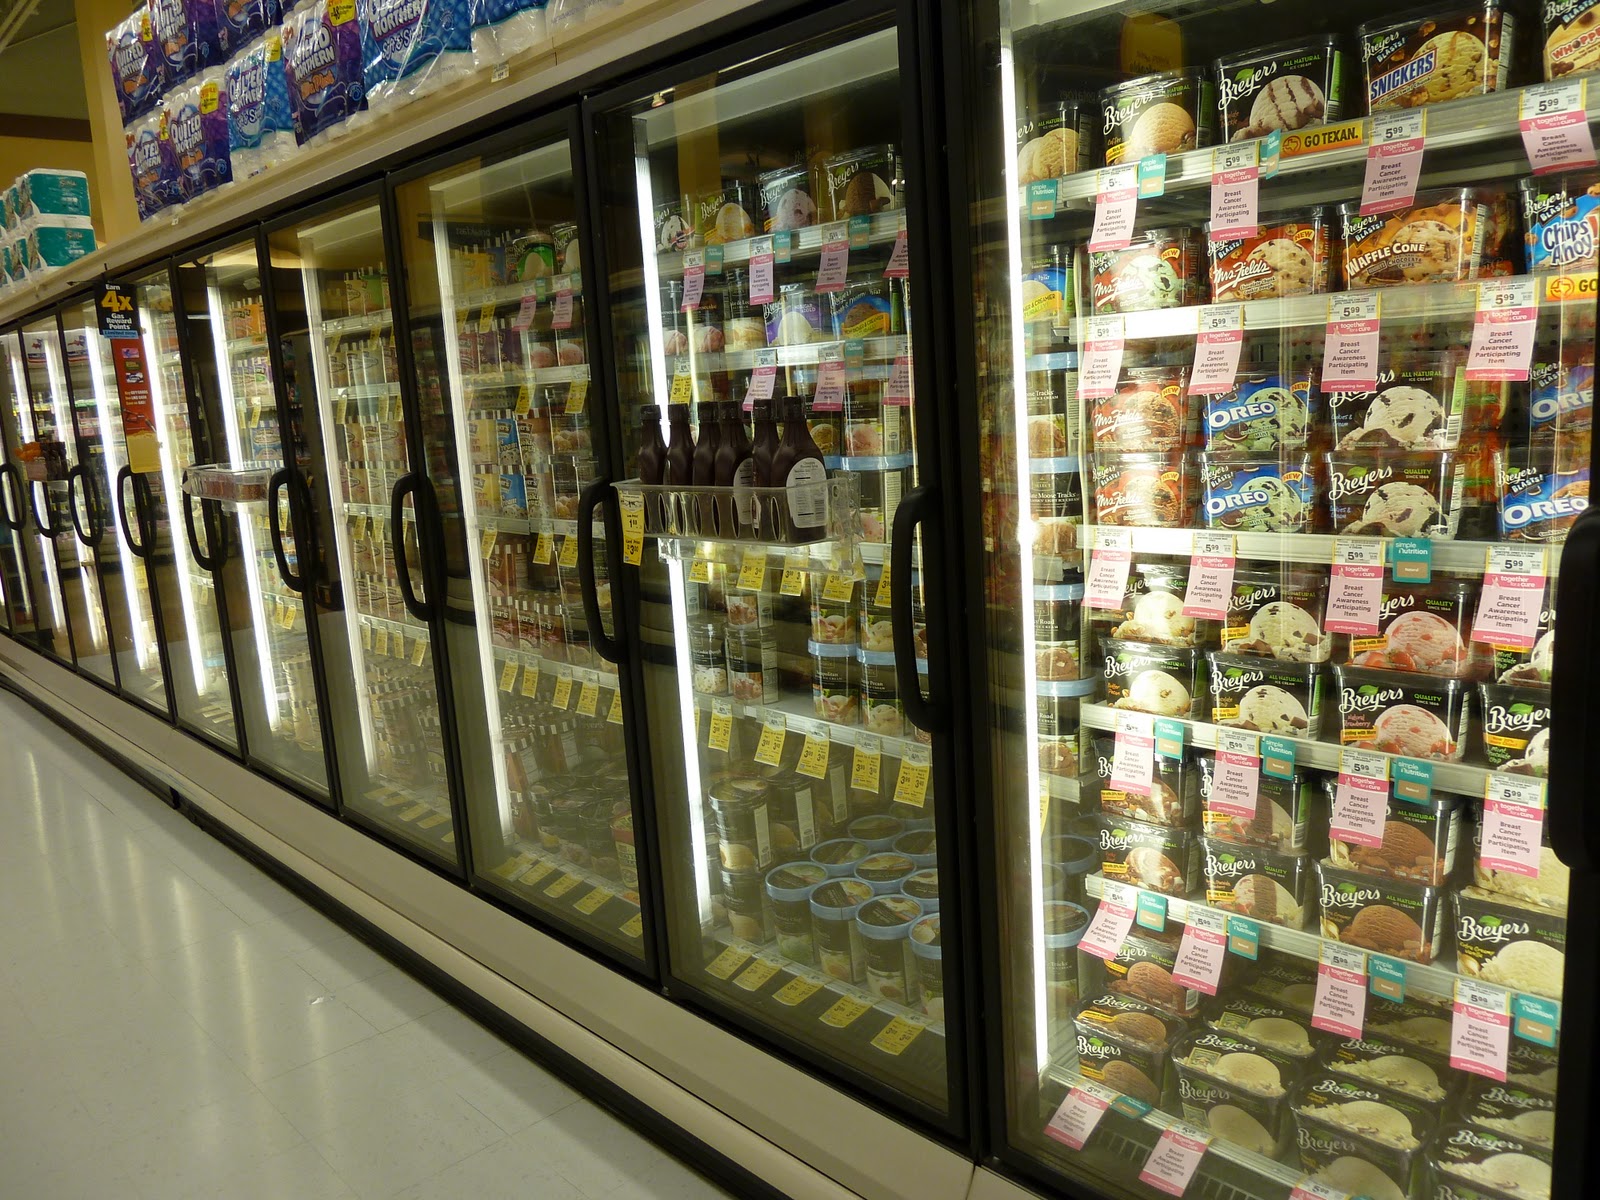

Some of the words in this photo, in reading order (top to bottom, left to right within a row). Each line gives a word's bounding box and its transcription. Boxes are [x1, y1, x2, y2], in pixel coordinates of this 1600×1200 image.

[373, 2, 425, 38] NORTHER
[1361, 31, 1400, 62] Breyers
[1376, 38, 1406, 63] BLASTS!
[1370, 52, 1435, 100] SNICKERS
[1218, 61, 1278, 111] Breyers
[1103, 92, 1154, 135] Breyers
[1304, 135, 1320, 148] GO
[1321, 127, 1359, 145] TEXAN.
[1379, 168, 1401, 177] Cancer
[1380, 162, 1401, 170] Breast
[828, 162, 859, 197] Breyers
[1368, 181, 1408, 193] Participating
[1372, 174, 1407, 185] Awareness
[1379, 189, 1395, 197] Item
[700, 192, 726, 221] Breyers
[1218, 202, 1247, 211] Awareness
[1523, 190, 1567, 218] Breyers
[1540, 196, 1575, 223] BLASTS!
[1215, 208, 1249, 218] Participating
[1341, 214, 1378, 239] Breyers
[1355, 220, 1384, 243] BLASTS!
[1542, 220, 1589, 249] Chips
[1161, 250, 1179, 259] NEW
[1346, 248, 1391, 276] WAFFLE
[1392, 243, 1425, 256] CONE
[1234, 260, 1271, 284] Fields
[101, 290, 134, 312] 4x
[106, 317, 133, 325] Reward
[1492, 310, 1521, 318] together
[1341, 321, 1366, 331] together
[1339, 347, 1361, 355] Cancer
[1475, 350, 1521, 358] Participating
[1328, 361, 1368, 369] Participating
[1162, 386, 1179, 396] NEW
[1208, 402, 1275, 427] OREO
[1100, 471, 1120, 486] BLASTS!
[1161, 472, 1178, 481] NEW
[1201, 465, 1229, 483] Breyers
[1210, 472, 1234, 488] BLASTS!
[1498, 466, 1537, 487] Breyers
[1329, 466, 1393, 501] Breyers
[1510, 474, 1544, 494] BLASTS!
[1206, 491, 1268, 513] OREO
[1504, 498, 1590, 525] OREO
[1345, 566, 1370, 574] together
[1500, 576, 1529, 584] together
[1342, 591, 1364, 599] Cancer
[1332, 604, 1371, 612] Participating
[1425, 599, 1454, 607] QUALITY
[1496, 601, 1520, 609] Cancer
[1482, 615, 1528, 624] Participating
[1488, 608, 1527, 616] Awareness
[1104, 655, 1151, 679] Breyers
[1210, 669, 1264, 694] Breyers
[1280, 674, 1307, 685] NATURAL
[1339, 687, 1404, 714] Breyers
[1414, 693, 1442, 701] QUALITY
[1485, 705, 1551, 733] Breyer
[1398, 761, 1420, 771] simple
[1348, 801, 1369, 810] Cancer
[1350, 795, 1369, 803] Breast
[1338, 812, 1376, 827] Participating
[1342, 807, 1374, 818] Awareness
[1409, 812, 1436, 821] NATURAL
[1499, 827, 1521, 837] Cancer
[1500, 821, 1521, 830] Breast
[1100, 829, 1144, 851] Breyers
[1488, 839, 1530, 853] Participating
[1492, 833, 1528, 845] Awareness
[1203, 854, 1255, 877] Breyers
[1264, 865, 1287, 874] QUALITY
[1319, 883, 1380, 909] Breyers
[1398, 896, 1424, 906] NATURAL
[1457, 916, 1529, 943] Breyers
[1093, 995, 1148, 1011] Breyers
[1467, 1030, 1489, 1041] Cancer
[1468, 1024, 1488, 1034] Breast
[1077, 1035, 1121, 1059] Breyers
[1195, 1034, 1256, 1051] Breyers
[1457, 1040, 1498, 1057] Participating
[1460, 1035, 1495, 1049] Awareness
[1179, 1079, 1230, 1102] Breyers
[1312, 1080, 1379, 1100] Breyers
[1481, 1087, 1553, 1108] Breyers
[1297, 1127, 1356, 1155] Breyers
[1448, 1129, 1523, 1151] Breyers
